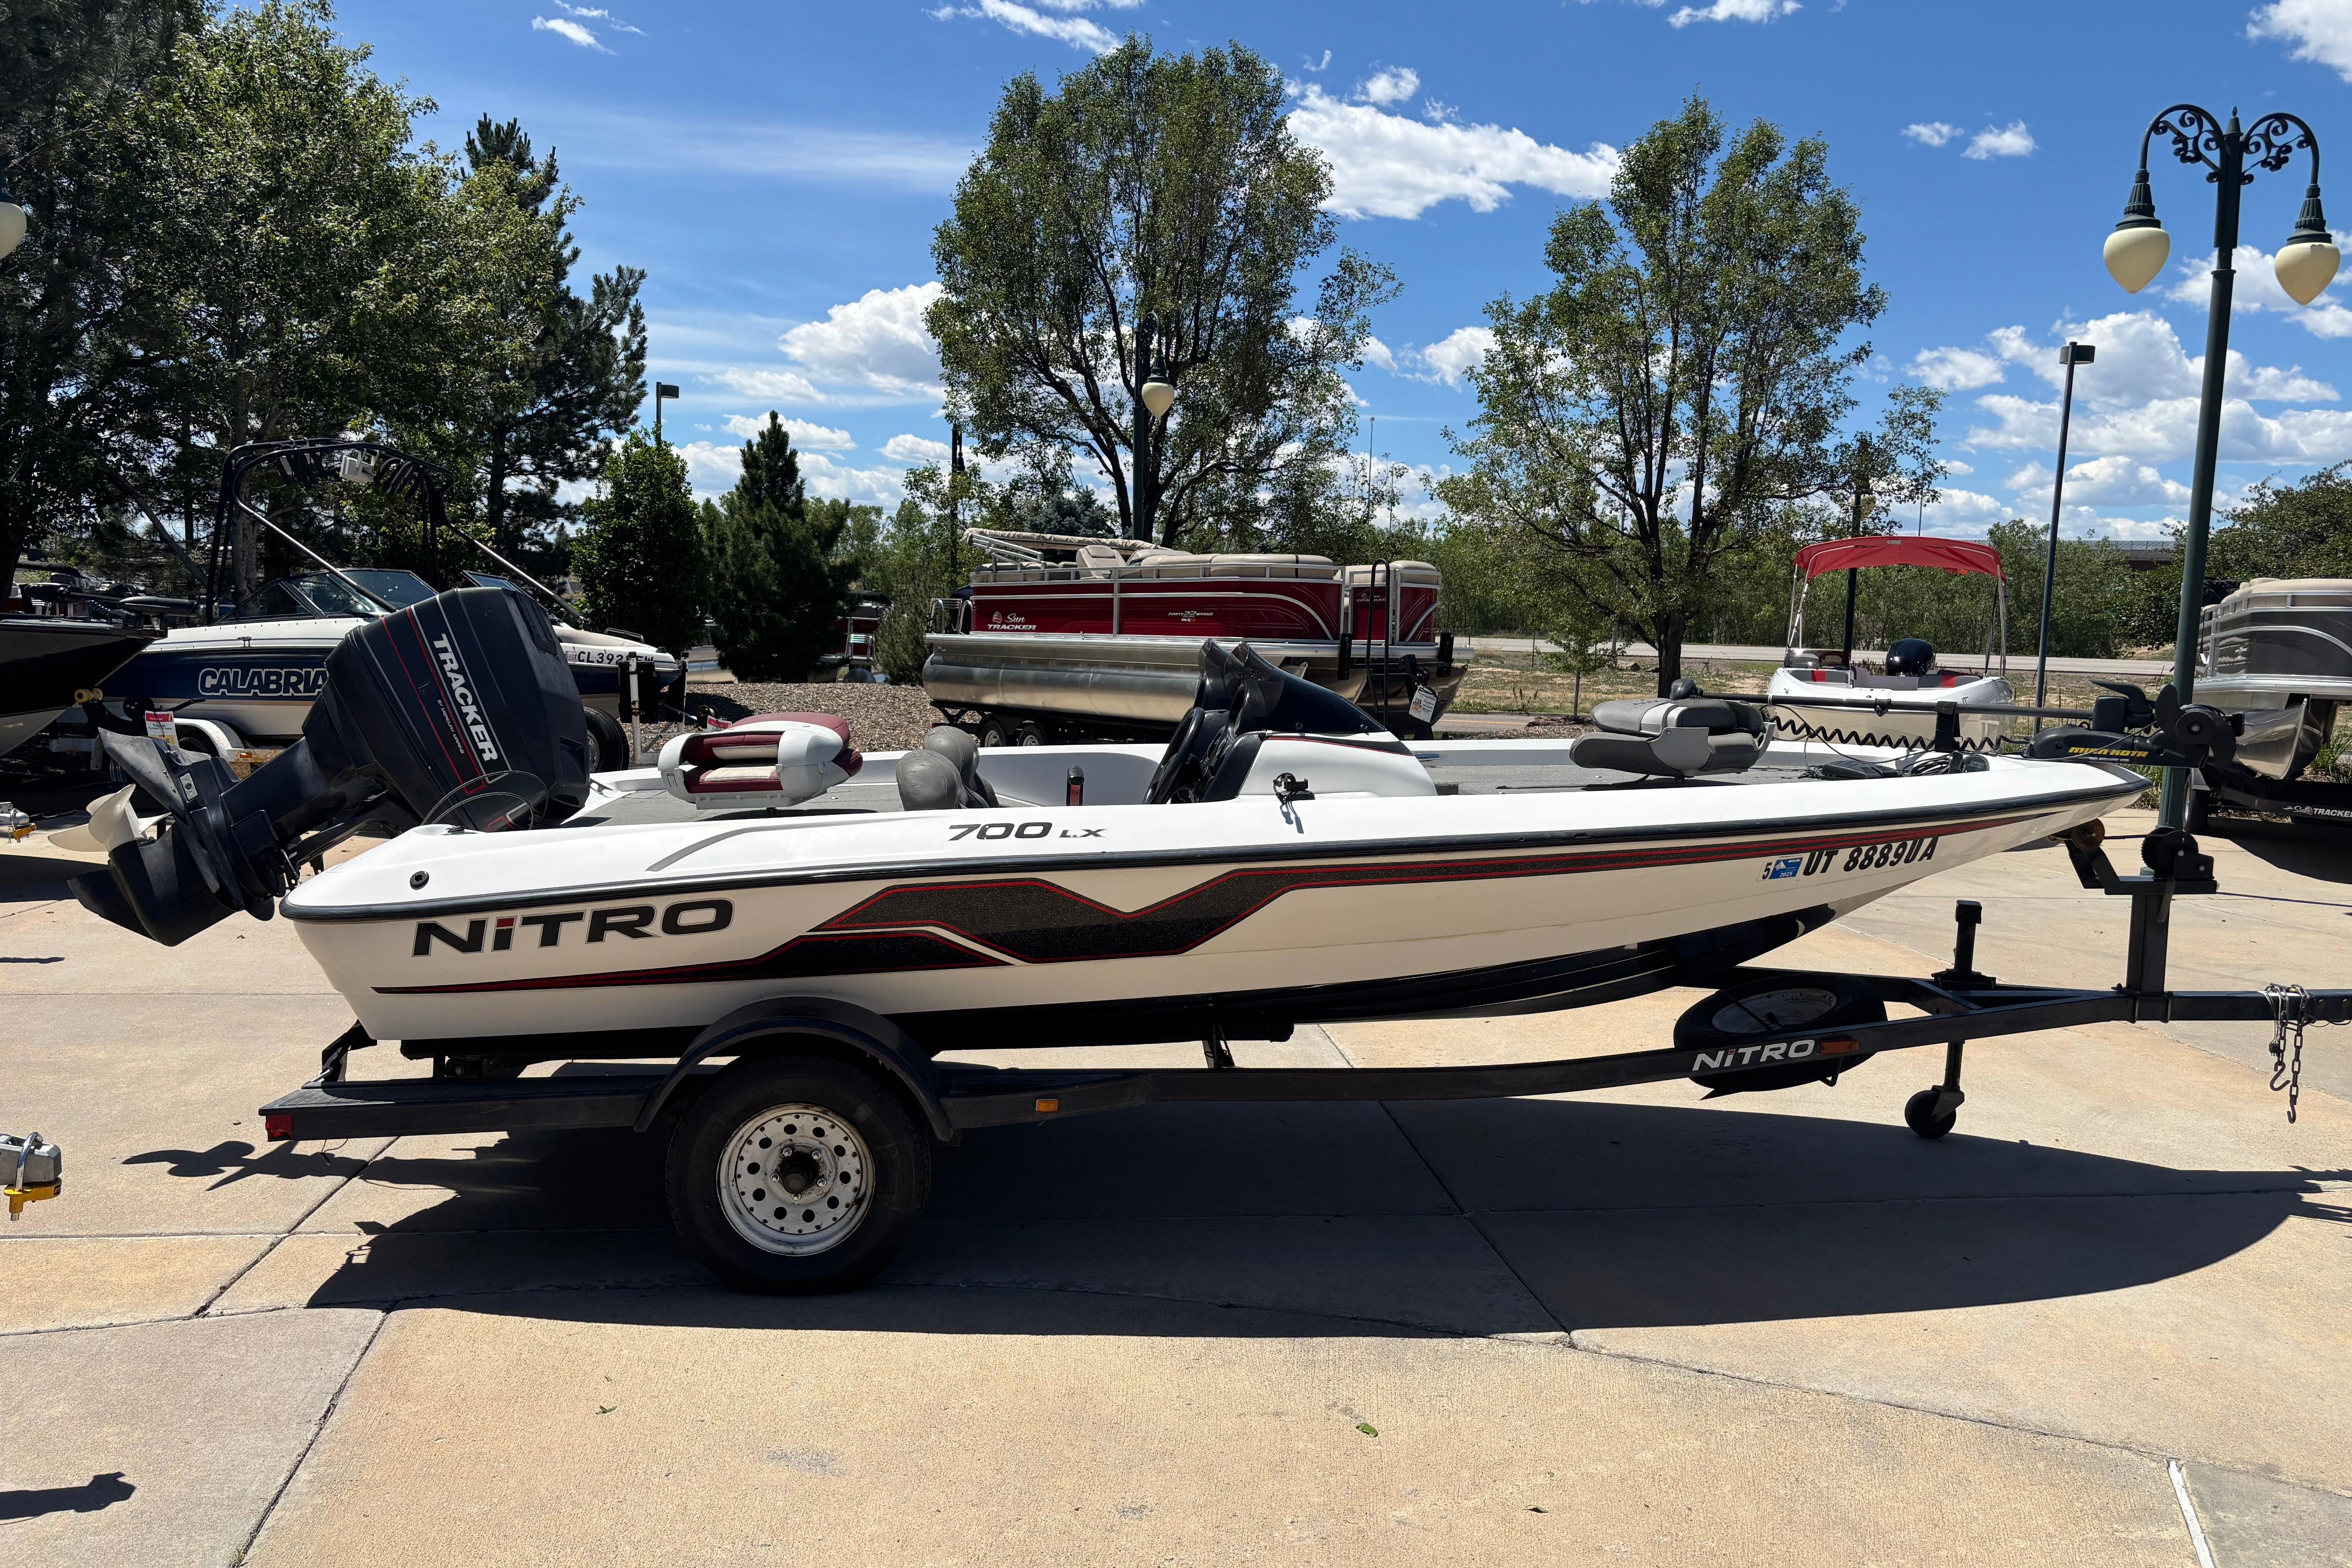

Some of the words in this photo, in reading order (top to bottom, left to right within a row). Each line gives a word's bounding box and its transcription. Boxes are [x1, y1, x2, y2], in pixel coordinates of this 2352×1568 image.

[1005, 613, 1025, 623] Sun
[198, 668, 329, 696] CALABRIA
[433, 633, 497, 761] TRACKER
[437, 700, 443, 708] BY
[441, 707, 455, 733] MERCURY
[453, 734, 464, 754] MARINE
[2068, 747, 2109, 755] MINN
[2109, 749, 2149, 757] KOTA
[948, 822, 1052, 841] 700
[1059, 828, 1108, 838] LX
[1803, 849, 1839, 876] UT
[1843, 836, 1939, 872] 8889UA
[1762, 862, 1772, 880] 5
